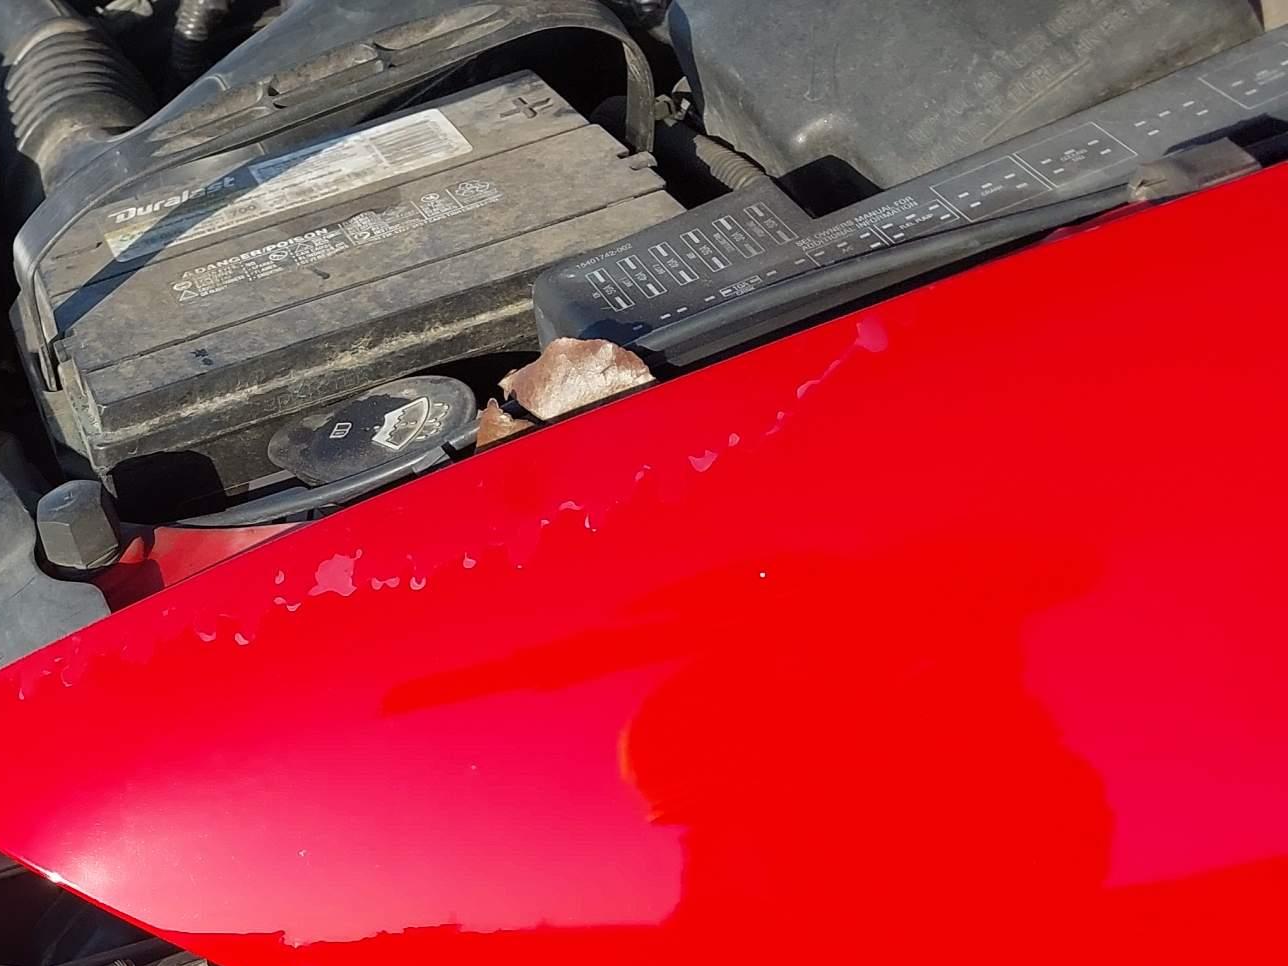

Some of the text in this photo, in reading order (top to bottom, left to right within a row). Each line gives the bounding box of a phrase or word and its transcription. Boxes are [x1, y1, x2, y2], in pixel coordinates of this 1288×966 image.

[108, 176, 235, 223] Duralast
[854, 204, 892, 223] MANUAL
[893, 195, 915, 207] FOR
[855, 201, 919, 229] INFORMATION
[194, 228, 328, 273] DANGER/POISON
